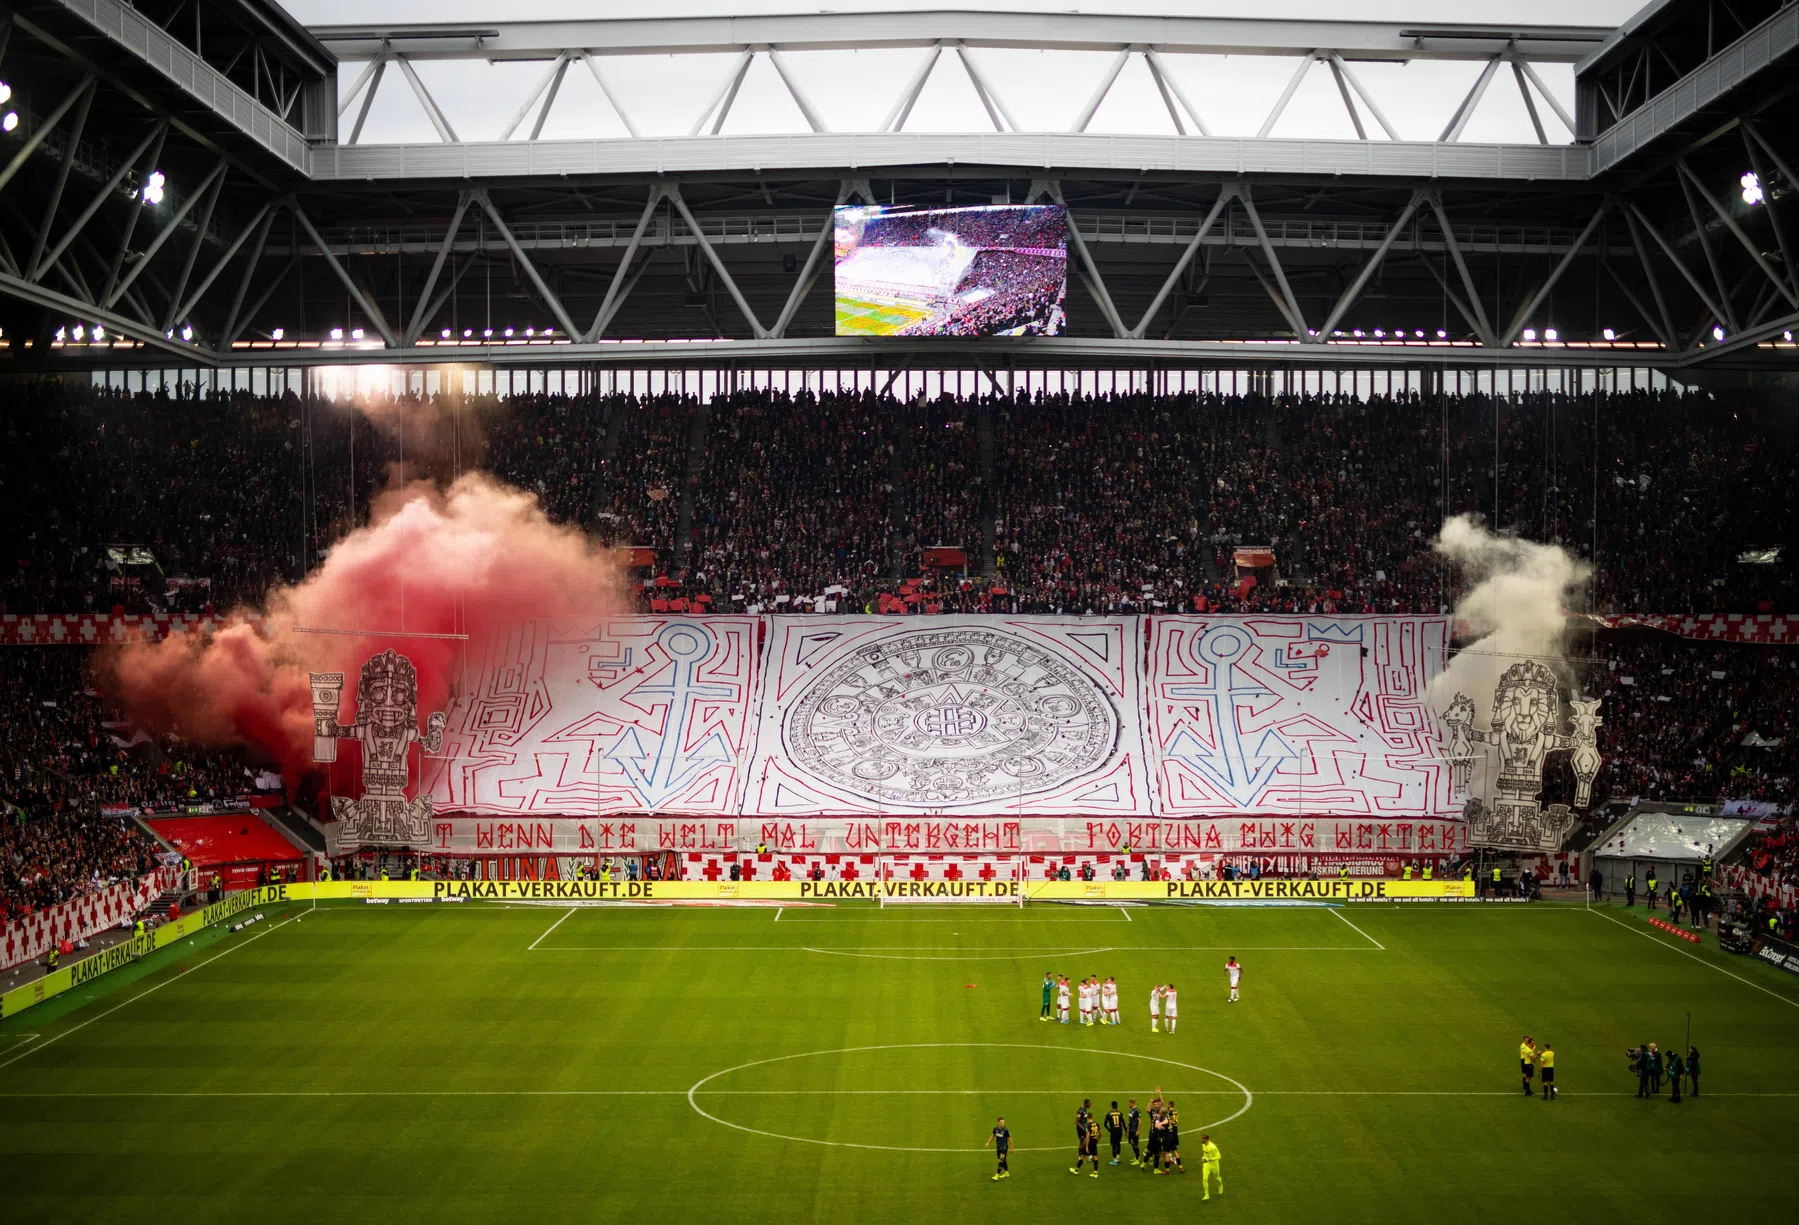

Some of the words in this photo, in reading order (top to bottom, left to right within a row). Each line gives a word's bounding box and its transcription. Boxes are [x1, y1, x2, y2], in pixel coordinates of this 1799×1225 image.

[476, 823, 553, 849] WENN
[578, 823, 636, 849] DIE
[659, 823, 735, 849] WELT
[761, 822, 815, 849] MAL
[845, 822, 1020, 849] UNTERGEHT
[1086, 822, 1222, 849] FORTUNA
[1240, 822, 1315, 848] EWIG
[1277, 855, 1308, 874] ULTRA
[434, 882, 653, 897] PLAKAT-VERKAUFT.DE
[801, 882, 1019, 897] PLAKAT-VERKAUFT.DE
[1168, 882, 1386, 897] PLAKAT-VERKAUFT.DE
[202, 885, 287, 926] PLAKAT-VERKAUFT.DE
